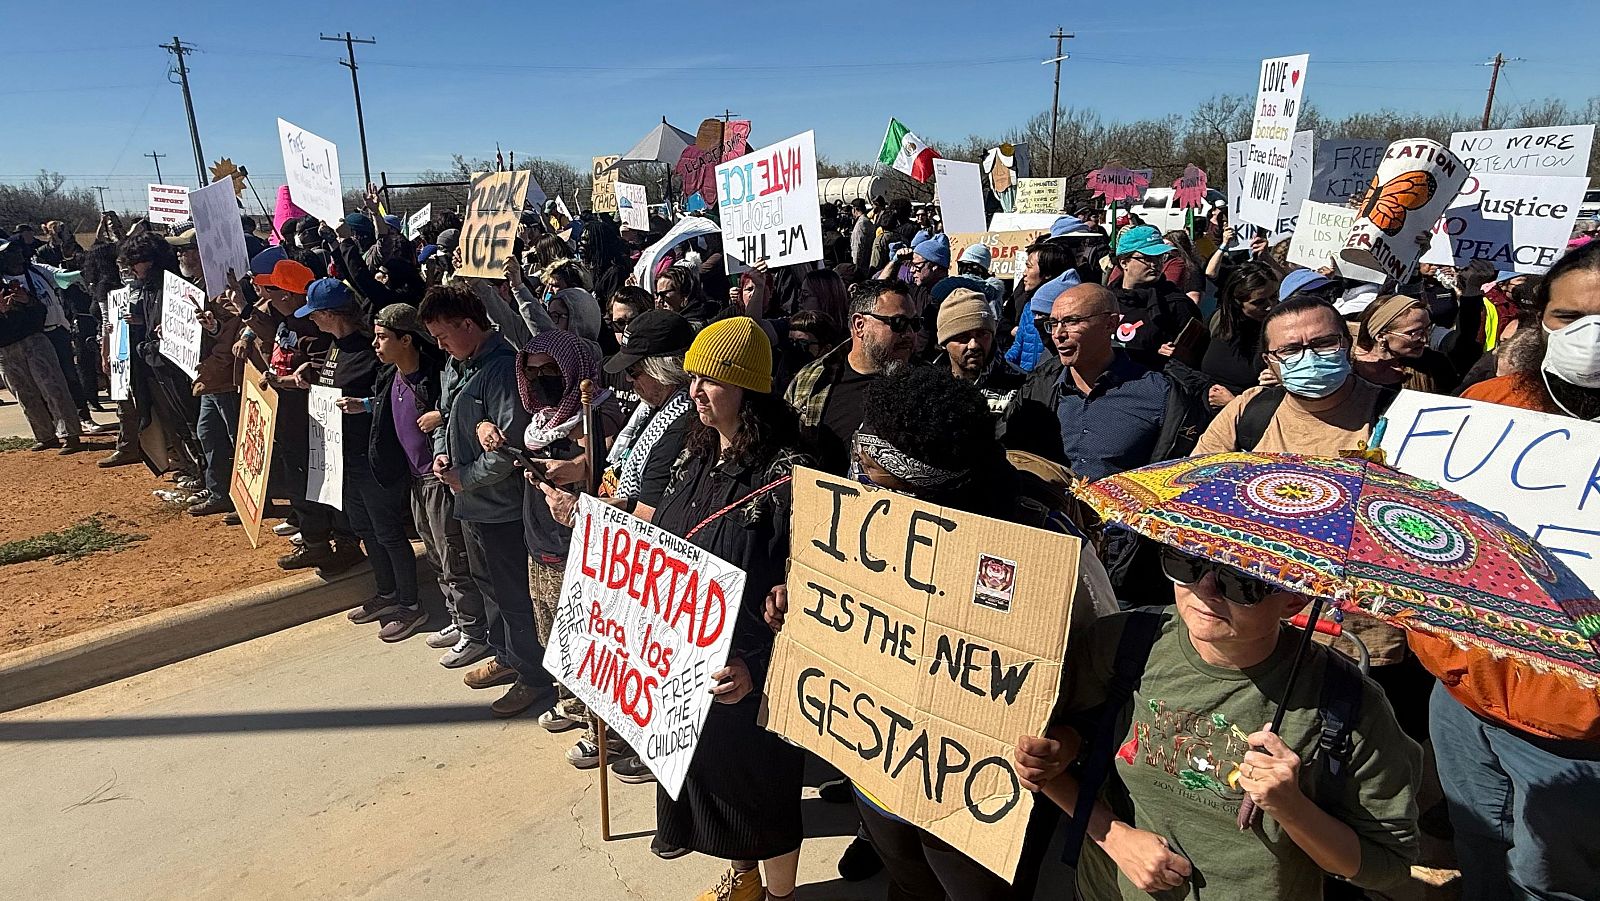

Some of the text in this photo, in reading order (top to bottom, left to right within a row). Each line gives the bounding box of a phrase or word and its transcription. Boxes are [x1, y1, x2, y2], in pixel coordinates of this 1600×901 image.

[1262, 61, 1288, 93] LOVE
[1260, 98, 1295, 118] has NO
[1254, 120, 1289, 142] borders
[1460, 134, 1575, 152] NO MORE
[1248, 144, 1267, 165] Free
[1268, 147, 1288, 169] them
[1333, 146, 1384, 170] FREE
[1464, 153, 1575, 173] DETENTION
[594, 183, 610, 193] THE
[718, 145, 801, 207] HATE ICE
[1096, 172, 1134, 186] FAMILIA
[723, 196, 784, 240] PEOPLE
[1472, 189, 1568, 219] Justice
[466, 221, 511, 269] ICE
[737, 224, 809, 266] WE THE
[980, 234, 1000, 246] US
[1308, 248, 1315, 258] A
[1313, 229, 1332, 242] LOS
[1452, 238, 1559, 267] PEACE
[603, 507, 701, 563] FREE THE CHILDREN
[811, 479, 958, 597] I.C.E.
[581, 513, 727, 648] LIBERTAD
[564, 595, 576, 635] THE
[570, 581, 587, 635] FREE
[556, 606, 574, 679] CHILDREN
[587, 601, 673, 679] Para los
[803, 581, 1034, 706] IS THE NEW
[577, 639, 658, 728] NIÑOS
[661, 660, 705, 709] FREE
[667, 698, 692, 728] THE
[647, 707, 702, 760] CHILDREN
[797, 667, 1020, 823] GESTAPO
[1153, 780, 1175, 793] ZION
[1177, 788, 1220, 811] THEATRE
